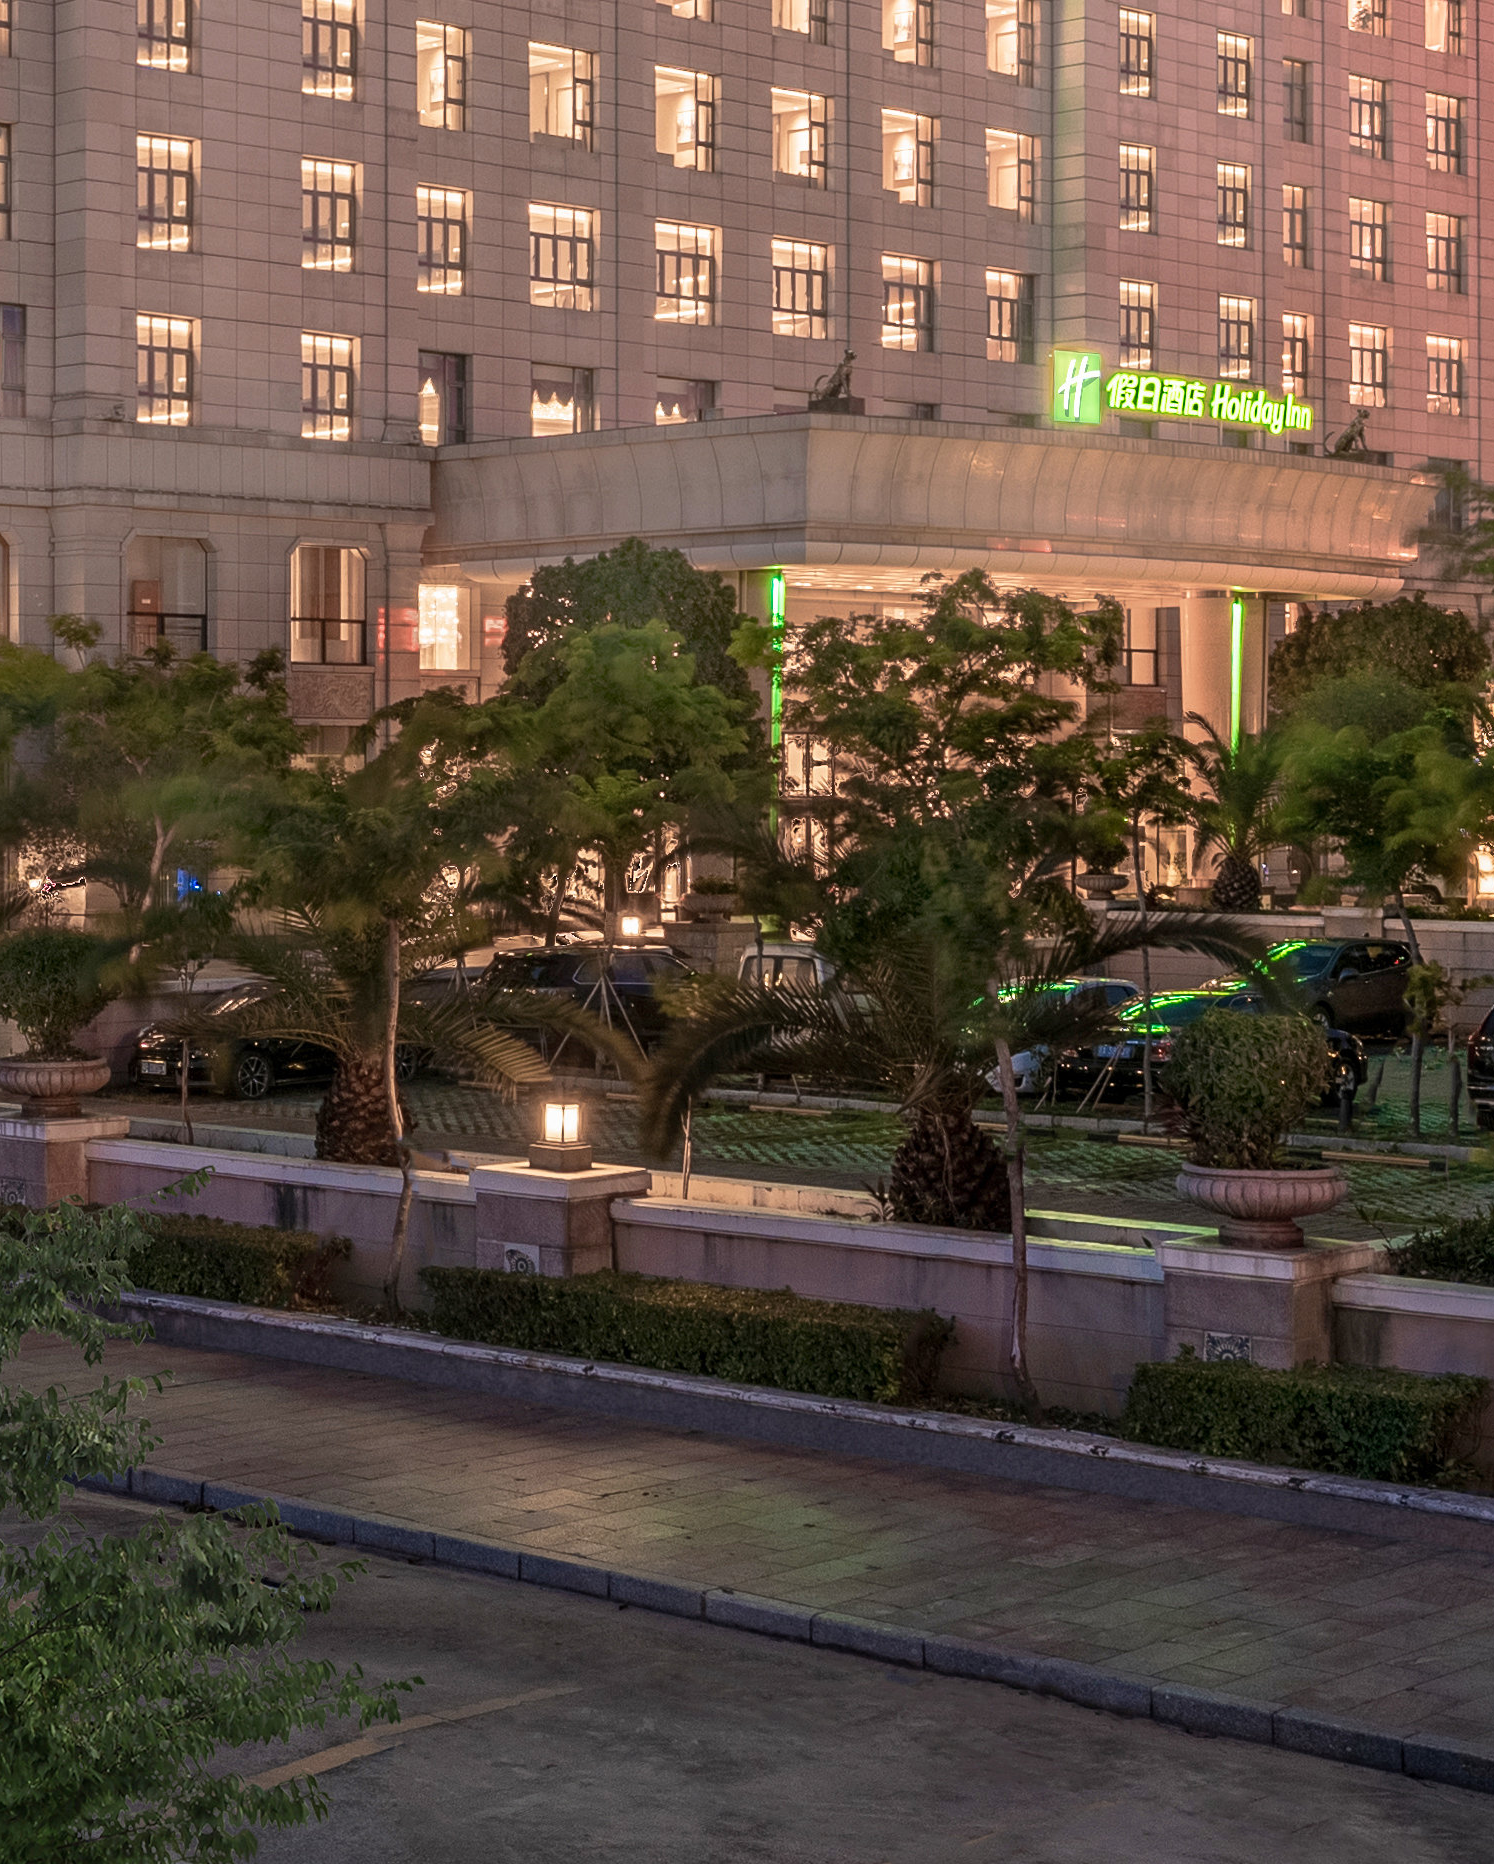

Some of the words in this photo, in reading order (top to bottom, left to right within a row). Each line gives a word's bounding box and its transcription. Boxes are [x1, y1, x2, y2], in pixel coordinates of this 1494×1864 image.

[1106, 373, 1207, 418] 假日酒店
[1211, 383, 1285, 435] Holiday
[1285, 392, 1313, 431] Inn
